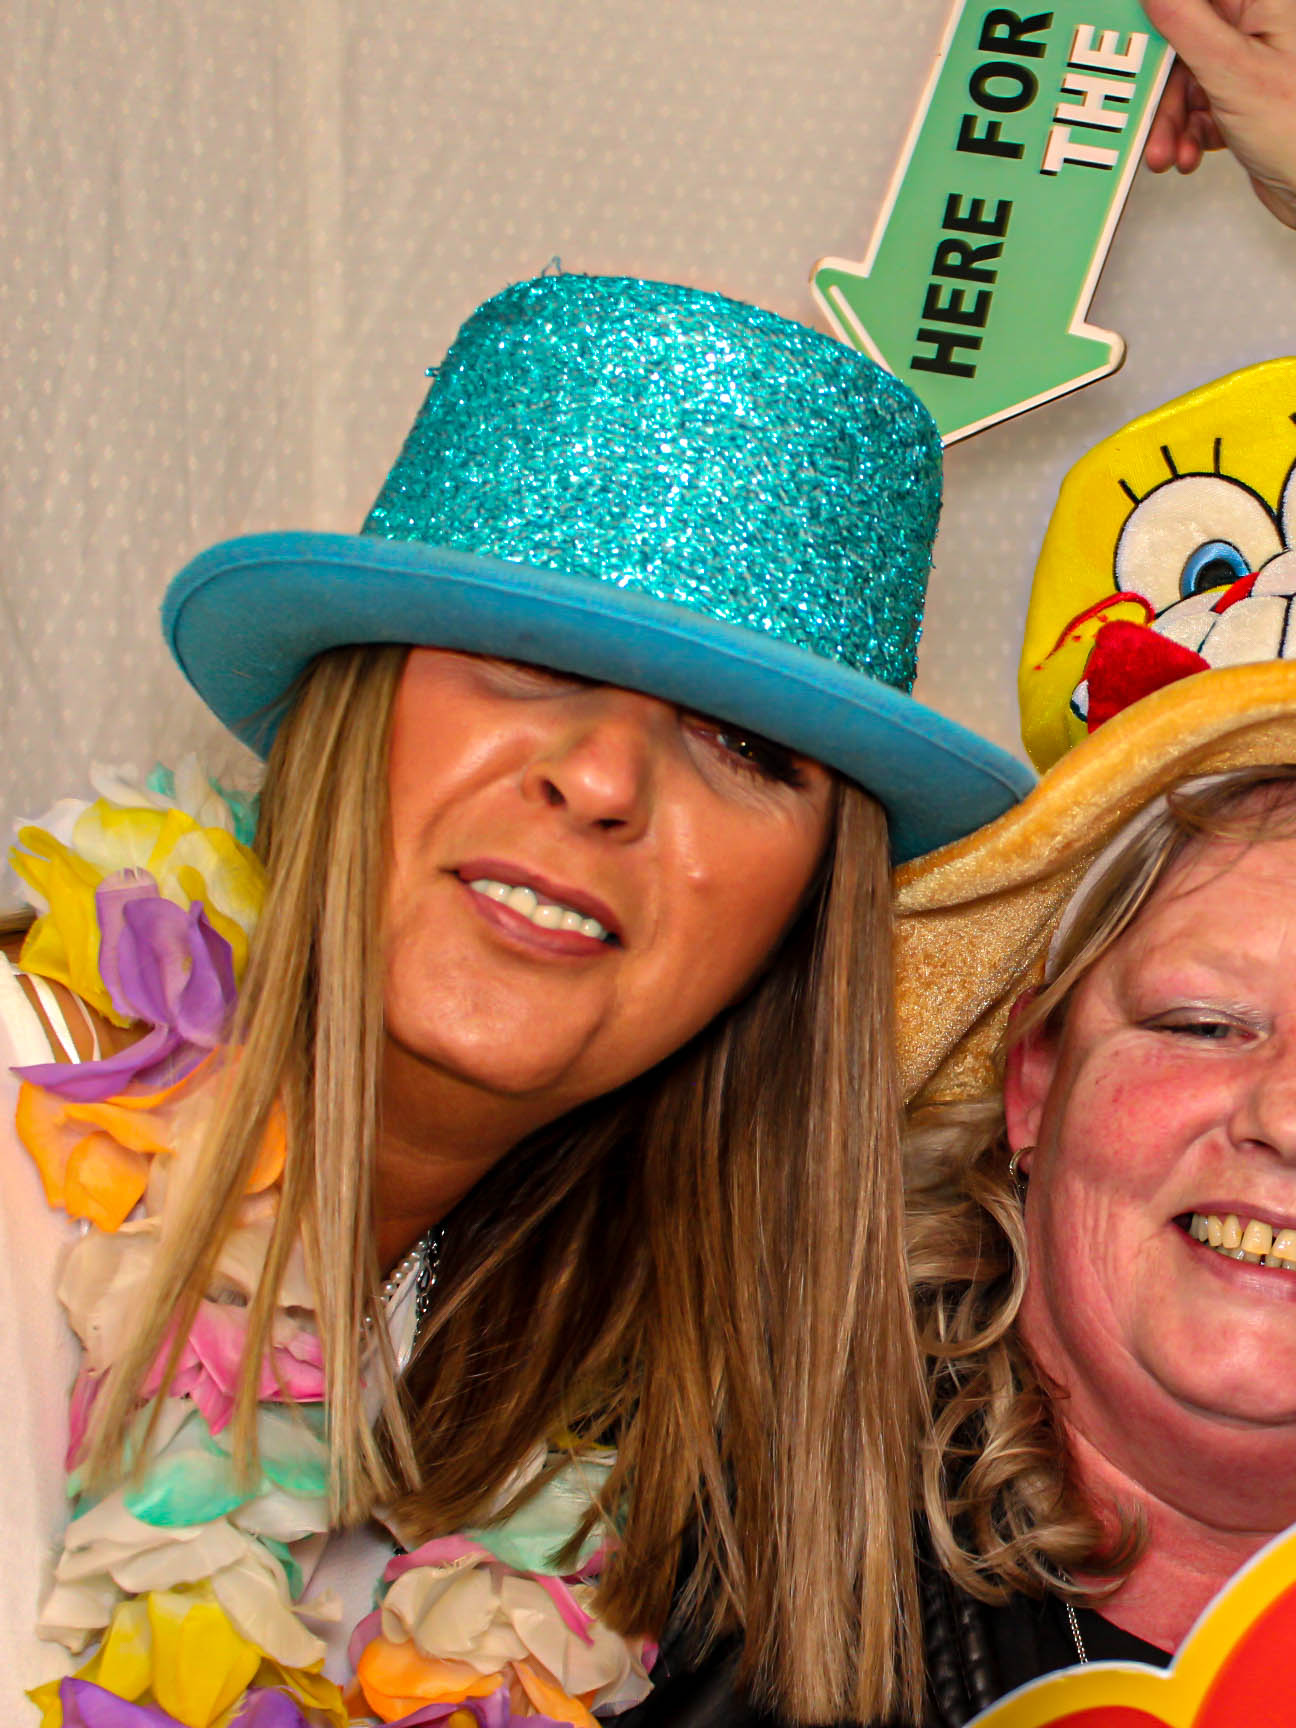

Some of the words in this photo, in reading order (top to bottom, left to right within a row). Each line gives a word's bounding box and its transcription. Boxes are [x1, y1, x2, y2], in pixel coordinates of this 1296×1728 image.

[956, 8, 1054, 160] FOR
[1039, 24, 1149, 176] THE
[910, 192, 1013, 379] HERE
